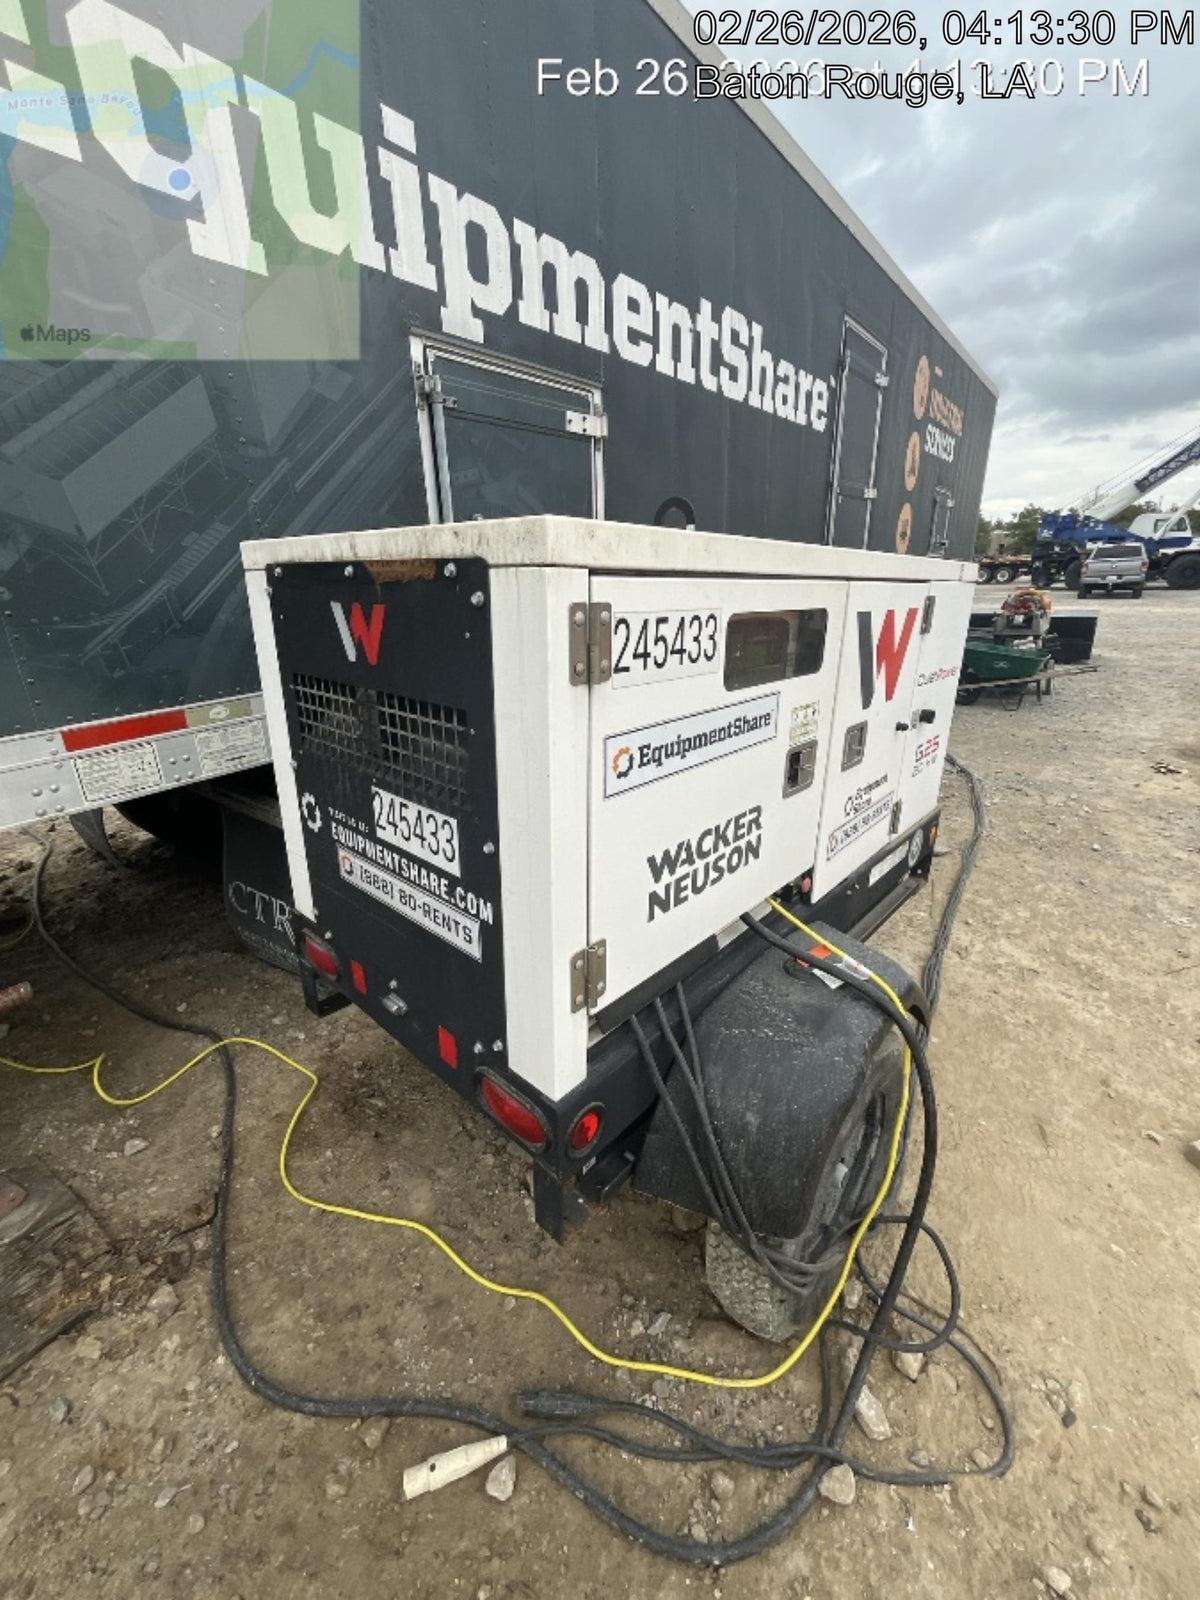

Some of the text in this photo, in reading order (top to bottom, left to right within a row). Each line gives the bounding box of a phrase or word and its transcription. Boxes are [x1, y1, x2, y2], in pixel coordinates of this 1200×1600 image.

[613, 613, 718, 675] 245433
[637, 711, 771, 769] EquipmentShare
[372, 791, 457, 863] 245433
[646, 804, 763, 885] WACKER
[331, 822, 494, 926] EQUIPMENTSHARE.COM
[646, 833, 762, 924] NEUSON
